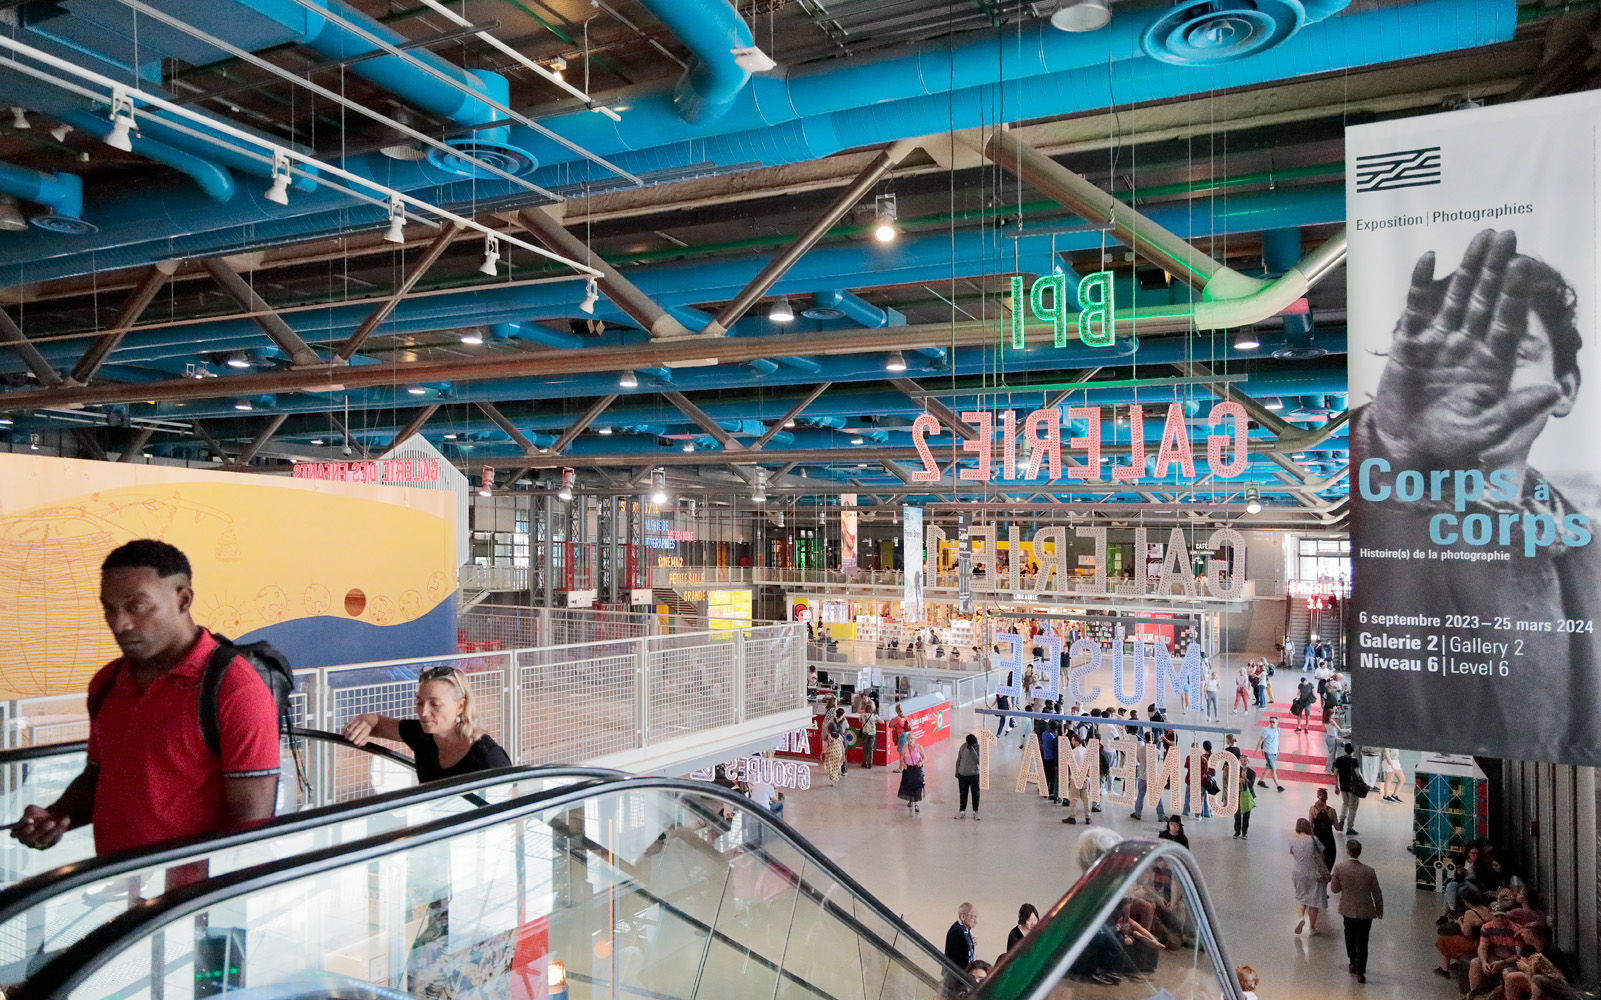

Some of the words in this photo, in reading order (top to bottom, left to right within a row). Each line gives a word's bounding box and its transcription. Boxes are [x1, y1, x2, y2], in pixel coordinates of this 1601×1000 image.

[1356, 214, 1423, 231] Exposition
[1433, 203, 1533, 224] Photographies
[1358, 457, 1518, 512] Corps
[1534, 478, 1550, 501] à
[1429, 513, 1592, 557] corps
[1360, 548, 1410, 560] Histoire(s)
[1413, 549, 1426, 559] de
[1428, 550, 1438, 559] la
[1441, 549, 1511, 562] photographie
[668, 573, 688, 584] PETITE
[683, 590, 705, 602] GRANDE
[1359, 611, 1367, 624] 6
[1371, 612, 1441, 628] septembre
[1516, 619, 1552, 632] mars
[1556, 620, 1594, 634] 2024
[1359, 631, 1422, 650] Galerie
[1427, 635, 1438, 651] 2
[1450, 636, 1508, 658] Gallery
[1514, 639, 1524, 656] 2
[1360, 653, 1421, 672] Niveau
[1427, 656, 1439, 673] 6
[1450, 657, 1493, 676] Level
[1499, 660, 1509, 677] 6
